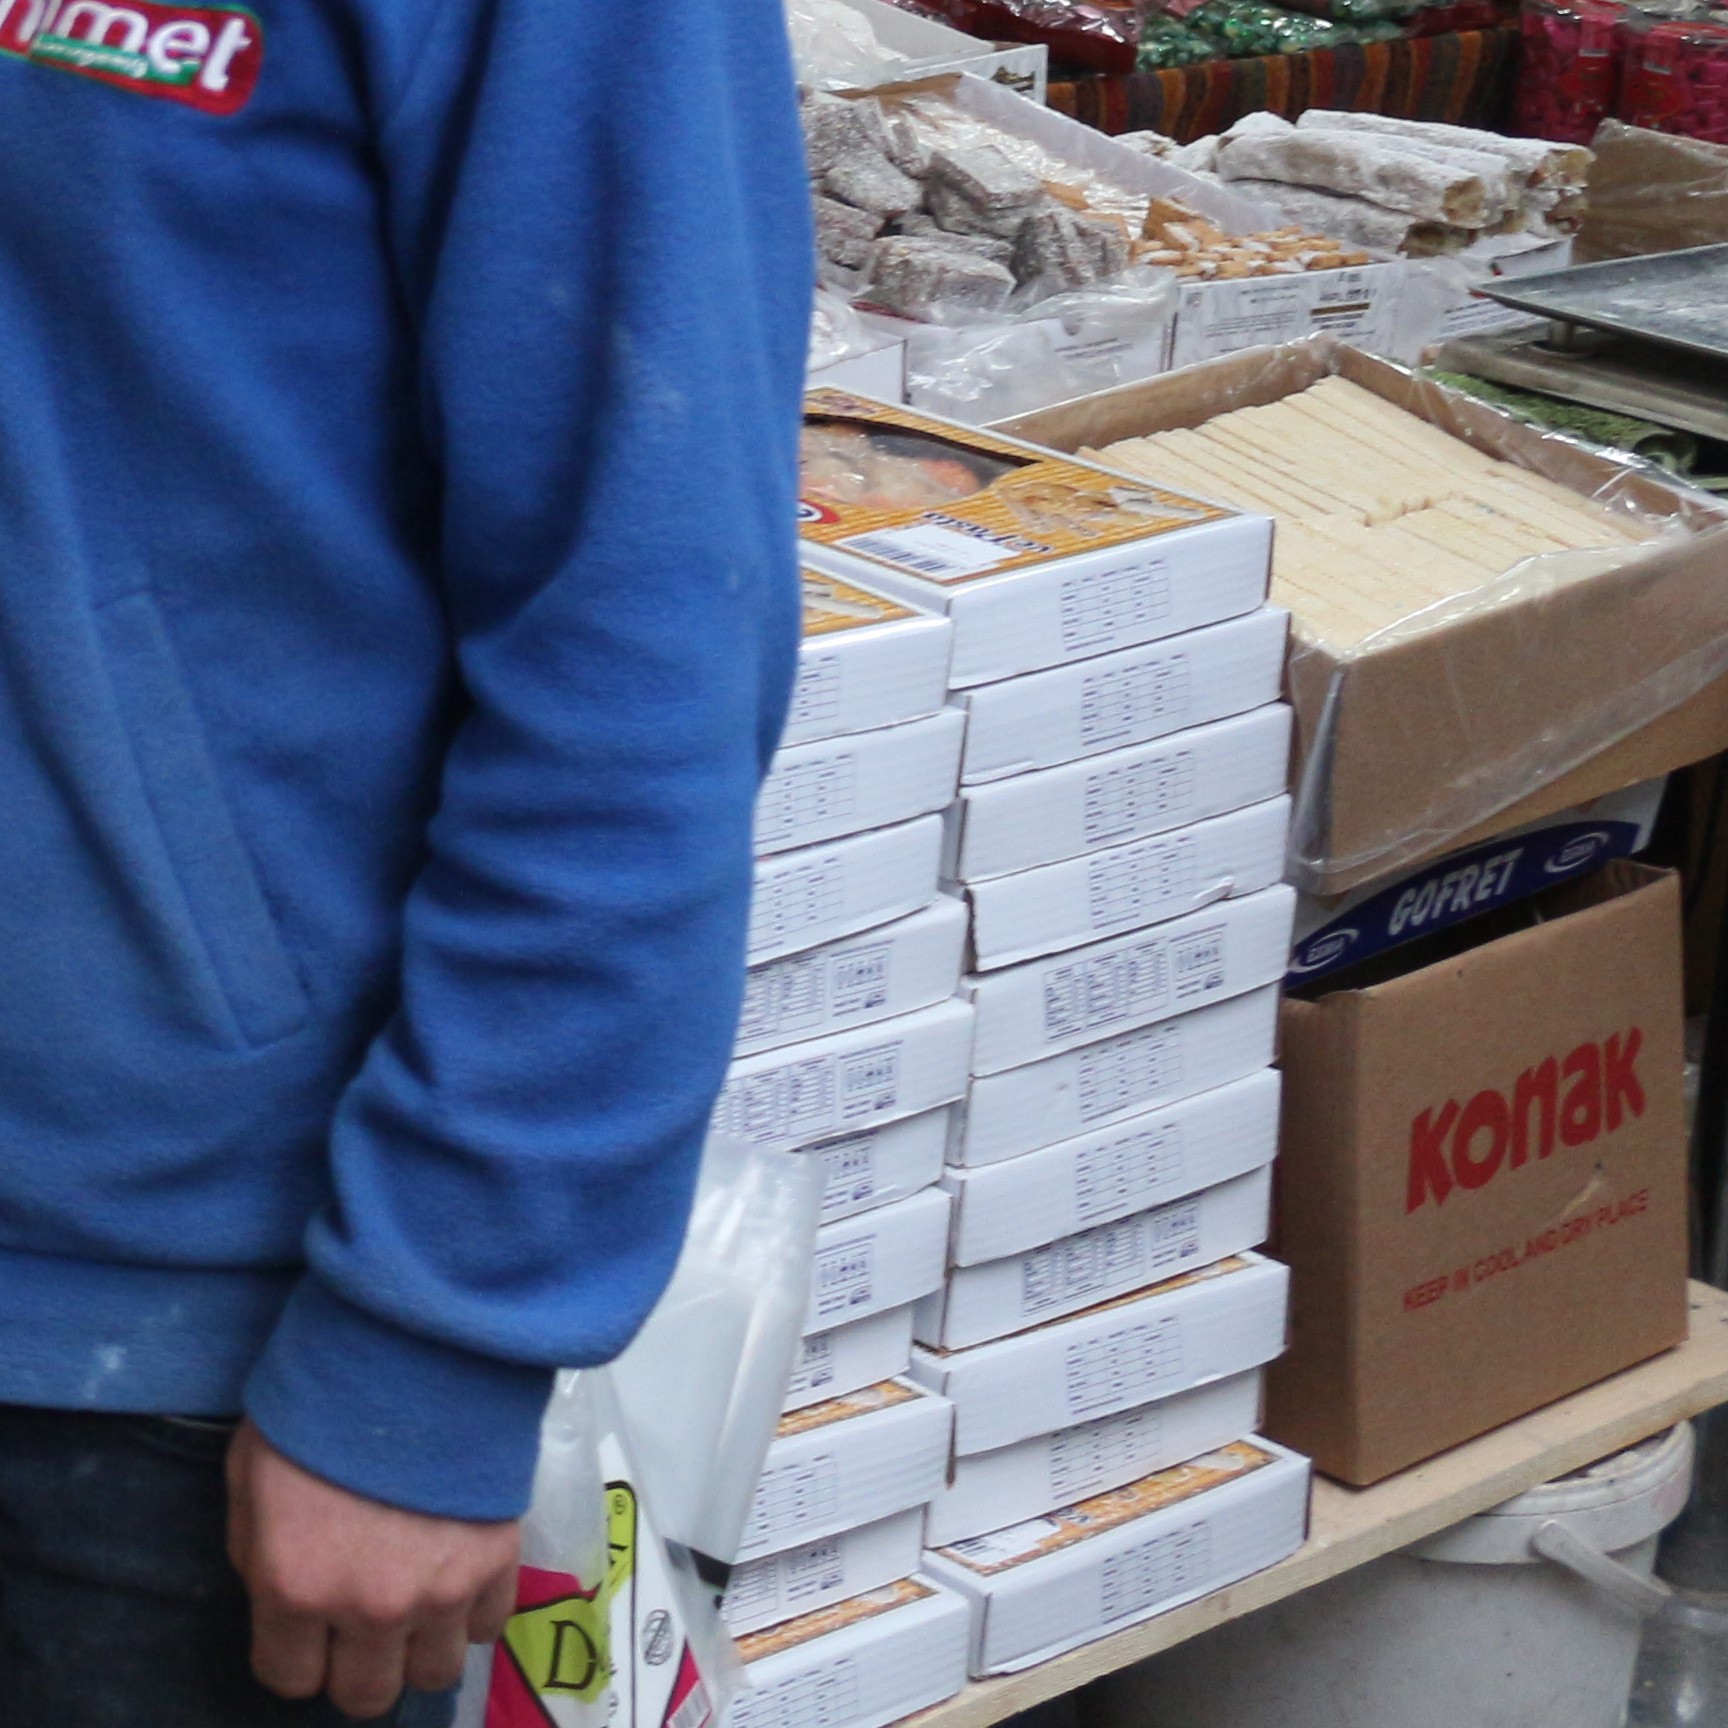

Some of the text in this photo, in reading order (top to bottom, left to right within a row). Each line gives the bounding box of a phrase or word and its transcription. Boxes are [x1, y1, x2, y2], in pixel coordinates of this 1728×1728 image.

[1388, 847, 1524, 937] GOFRET
[1403, 1188, 1648, 1312] KEEP IN COOL AND DRY PLACE
